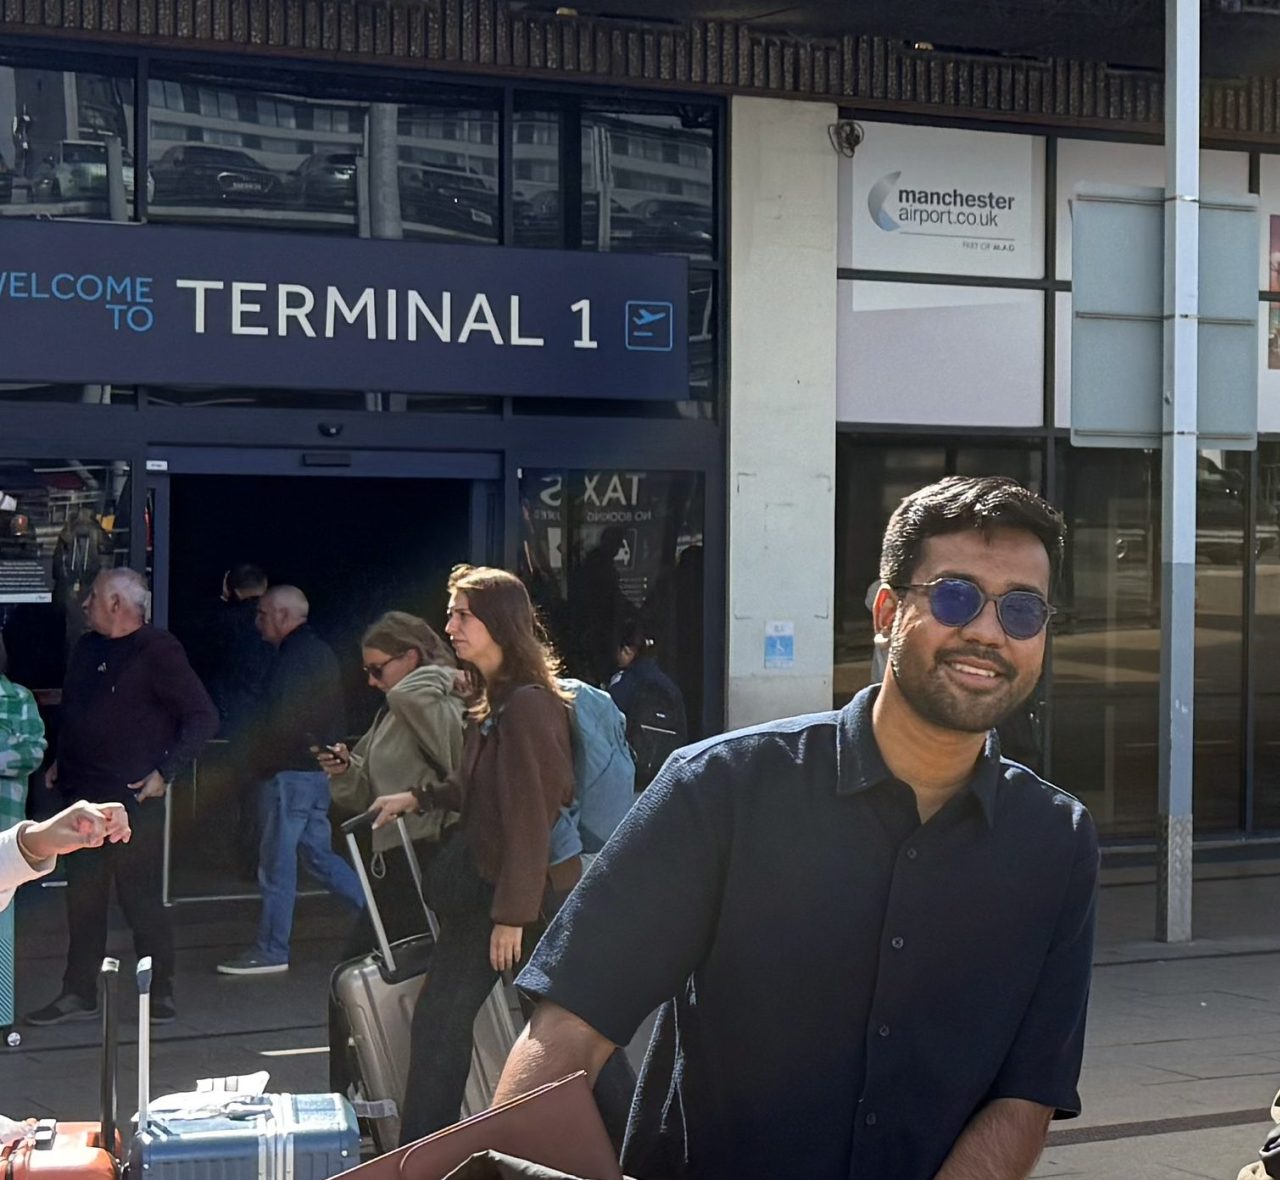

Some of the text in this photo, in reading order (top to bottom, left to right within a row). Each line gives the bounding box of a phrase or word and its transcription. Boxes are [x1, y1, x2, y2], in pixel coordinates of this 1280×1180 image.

[898, 188, 1015, 210] manchester
[898, 204, 998, 227] airport.co.uk
[0, 271, 153, 303] ELCOME
[105, 303, 154, 332] TO
[176, 278, 598, 349] TERMINAL 1
